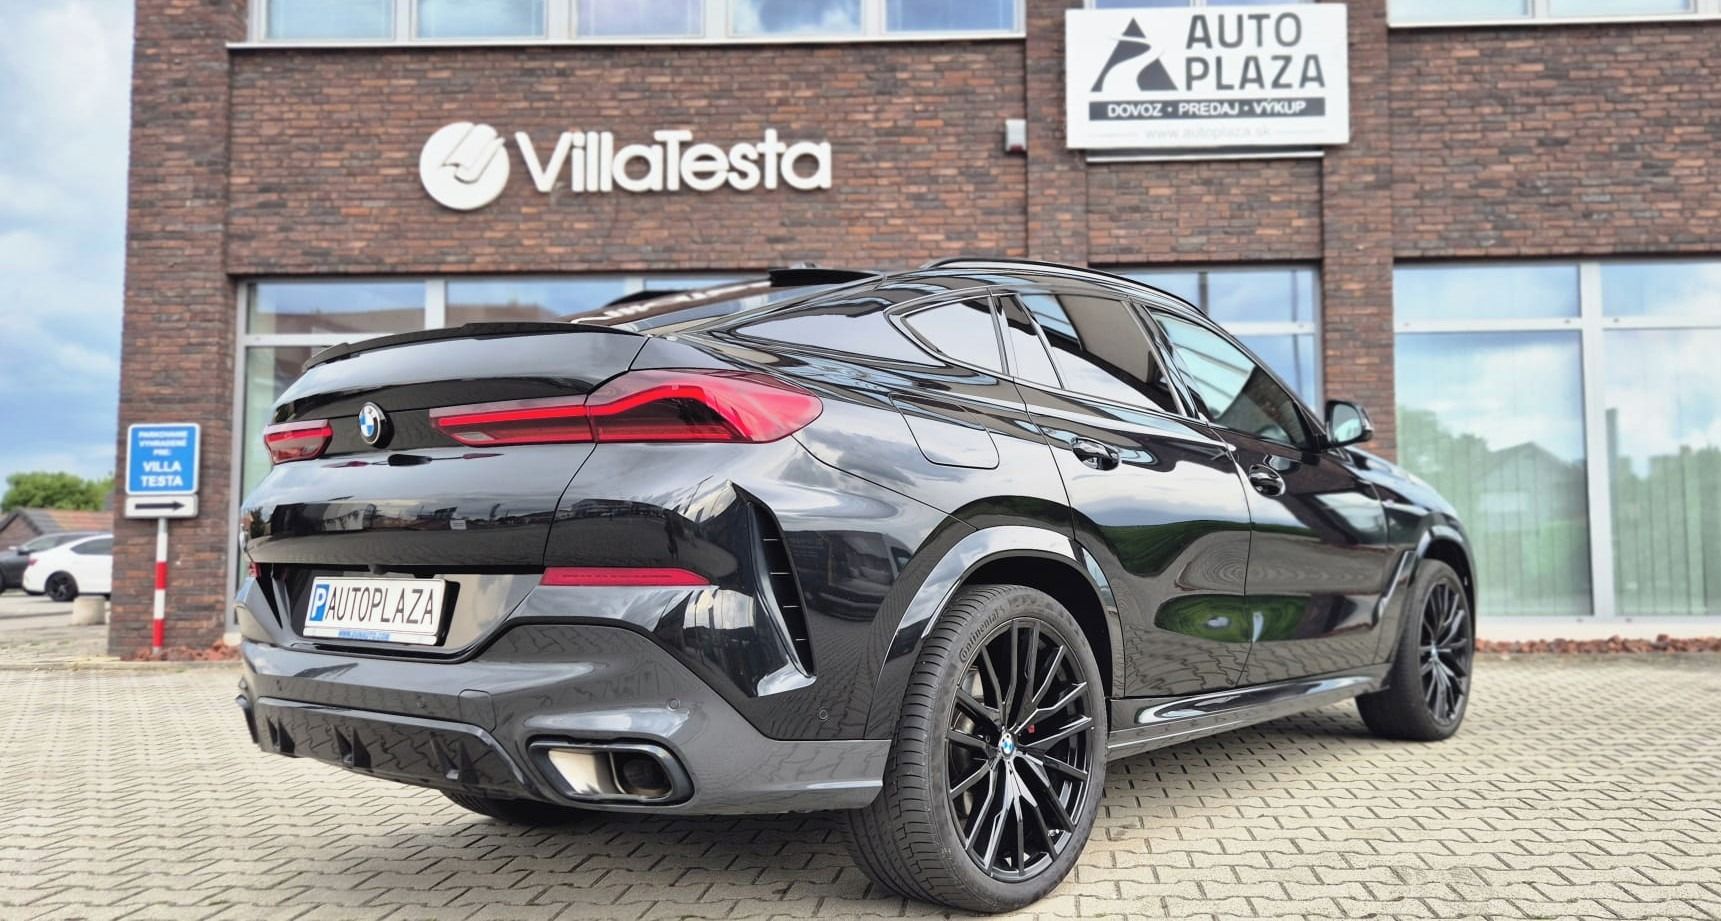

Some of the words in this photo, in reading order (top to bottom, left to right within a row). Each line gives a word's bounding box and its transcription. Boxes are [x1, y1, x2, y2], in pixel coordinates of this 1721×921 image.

[1186, 12, 1302, 49] AUTO
[1185, 54, 1325, 91] PLAZA
[1107, 102, 1163, 118] DOVOZ
[1178, 101, 1240, 117] PREDAJ
[1253, 98, 1306, 115] VÝKUP
[1145, 126, 1272, 140] www.autoplaza.sk
[514, 128, 832, 193] VillaTesta
[140, 475, 184, 487] TESTA
[142, 461, 182, 472] VILLA
[325, 585, 434, 625] AUTOPLAZA
[959, 607, 1001, 663] Continental
